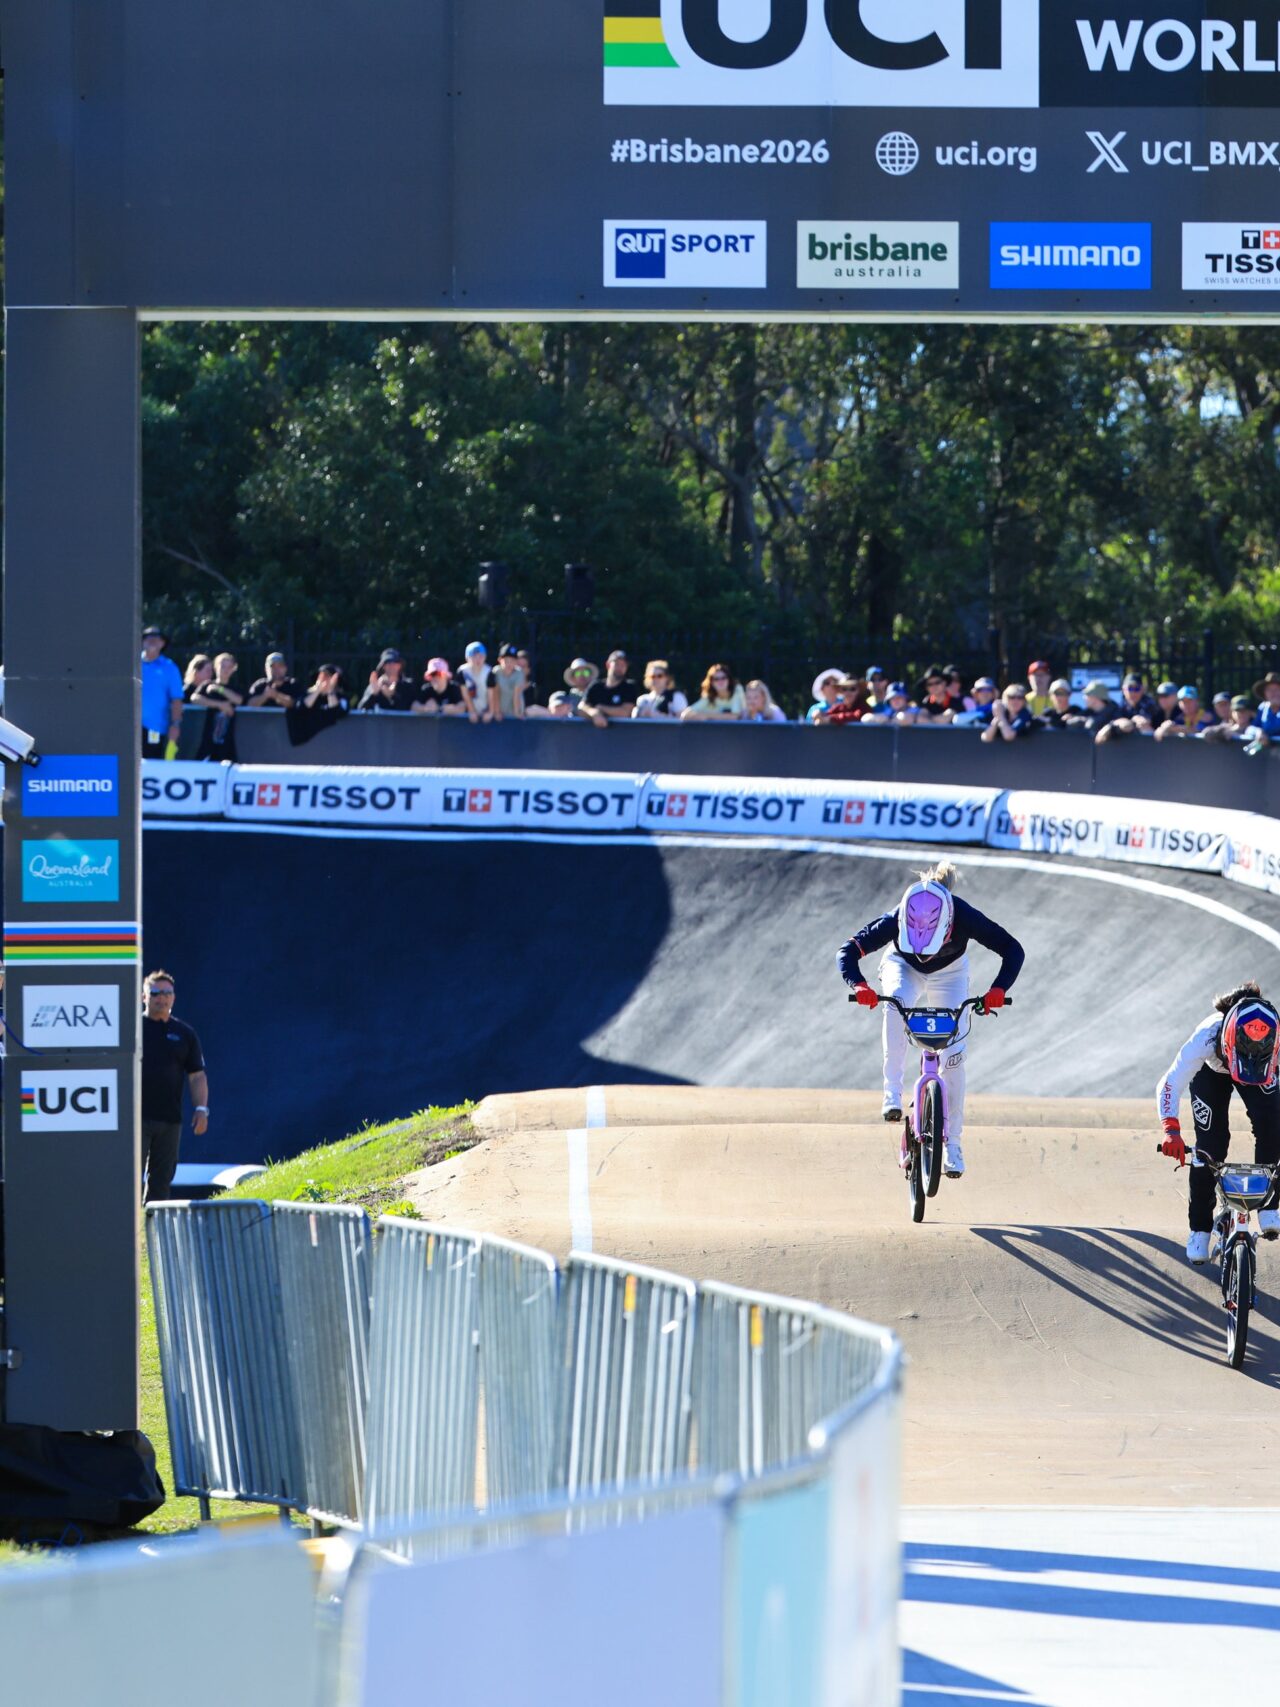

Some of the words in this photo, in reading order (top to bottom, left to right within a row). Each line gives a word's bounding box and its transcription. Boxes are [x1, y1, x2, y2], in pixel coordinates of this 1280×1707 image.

[681, 0, 1001, 70] UCI
[611, 138, 829, 164] #Brisbane2026
[936, 141, 1037, 172] uci.org
[617, 233, 664, 253] QUT
[671, 235, 755, 253] SPORT
[808, 233, 947, 262] brisbane
[1001, 245, 1140, 267] SHIMANO
[834, 266, 921, 278] australia
[1204, 277, 1230, 285] SWISS
[1232, 277, 1272, 285] WATCHES
[28, 779, 113, 793] SHIMANO
[286, 785, 421, 811] TISSOT
[498, 790, 634, 816] TISSOT
[692, 795, 805, 822] TISSOT
[870, 802, 984, 828] TISSOT
[1030, 814, 1104, 842] TISSOT
[29, 854, 112, 879] Queensland
[926, 1018, 936, 1032] 3
[38, 1086, 110, 1115] UCI
[1164, 1082, 1173, 1114] JAPAN
[1241, 1176, 1249, 1192] 1
